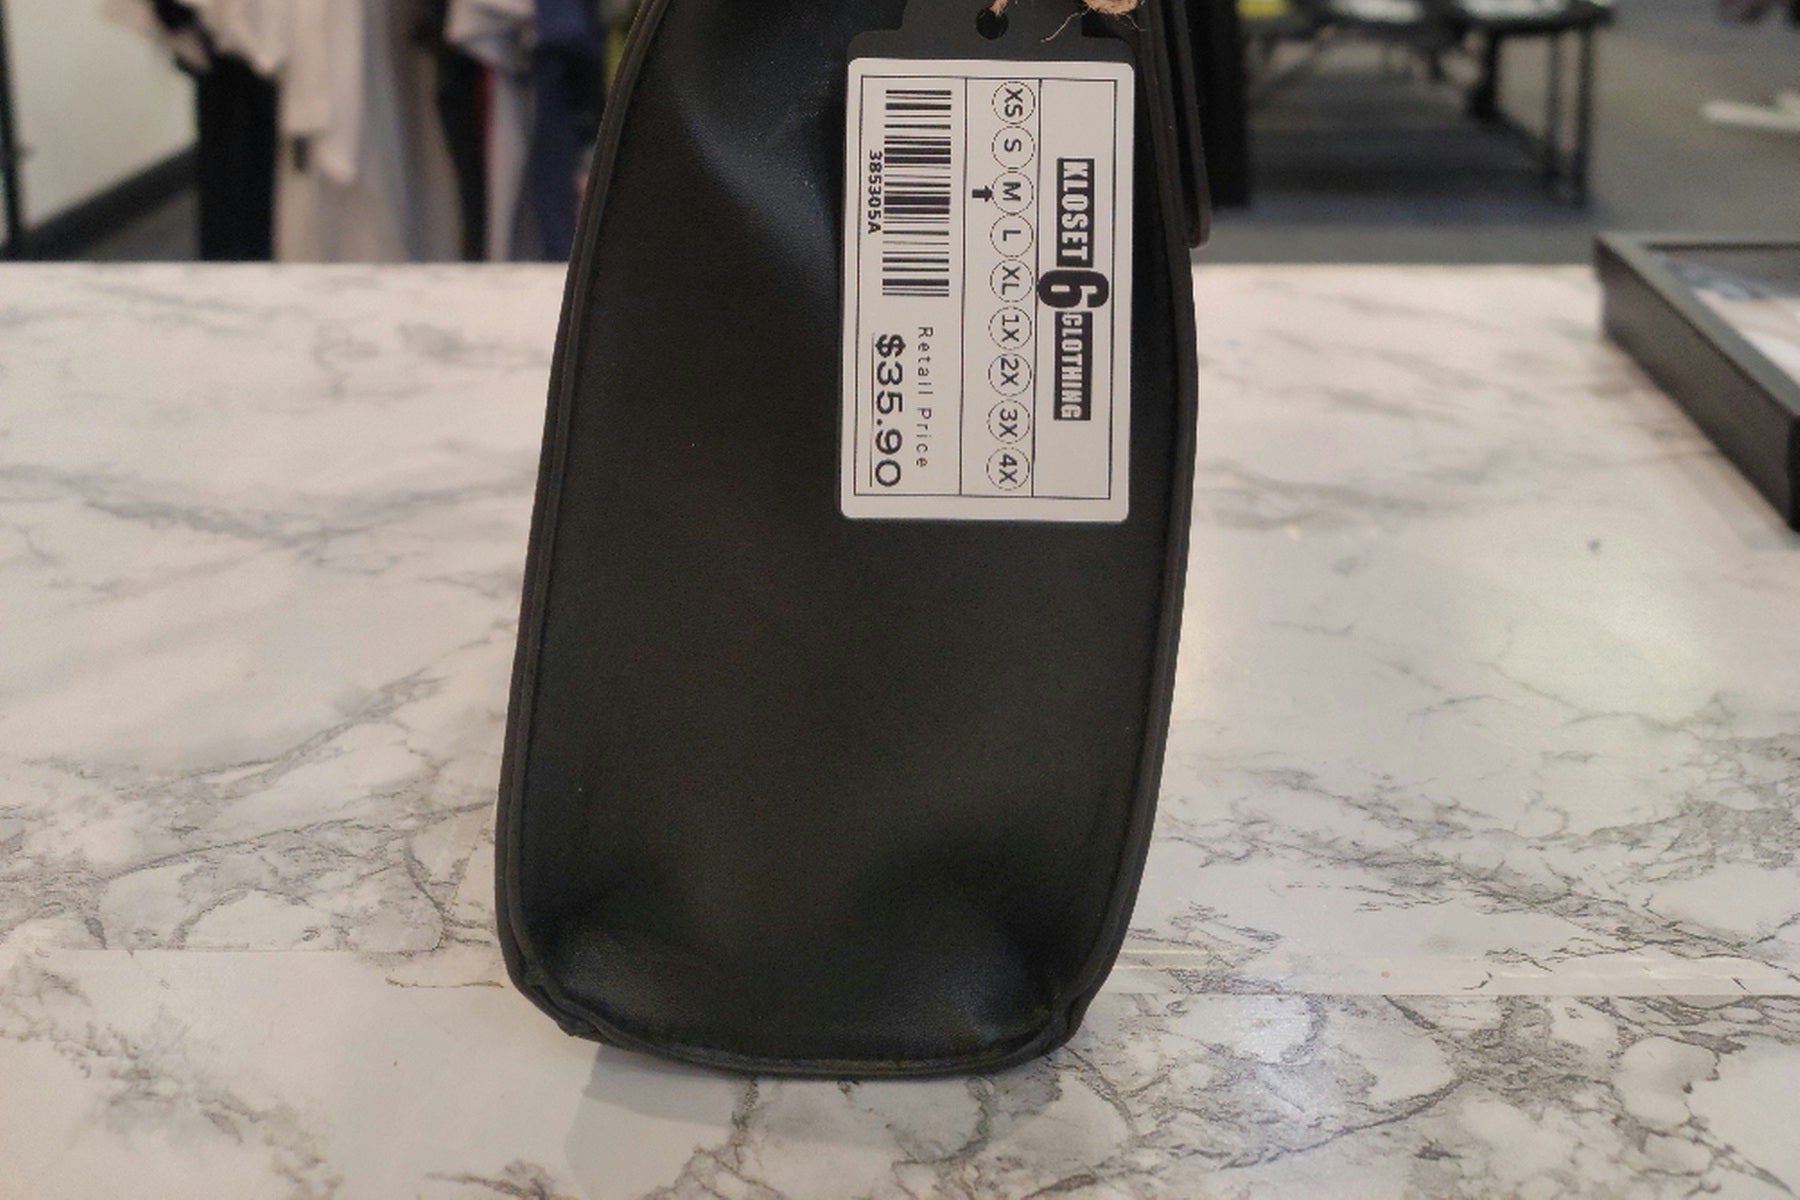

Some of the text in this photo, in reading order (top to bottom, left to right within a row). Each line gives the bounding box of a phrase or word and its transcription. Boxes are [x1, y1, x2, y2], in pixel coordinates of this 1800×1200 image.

[867, 149, 883, 235] 385305A
[999, 86, 1023, 484] XS S M L XL 1X 2X 3X 4X
[1037, 160, 1109, 419] KLOSET 6 CLOTHING
[875, 333, 906, 487] $35.90
[916, 326, 934, 468] Retail Price
